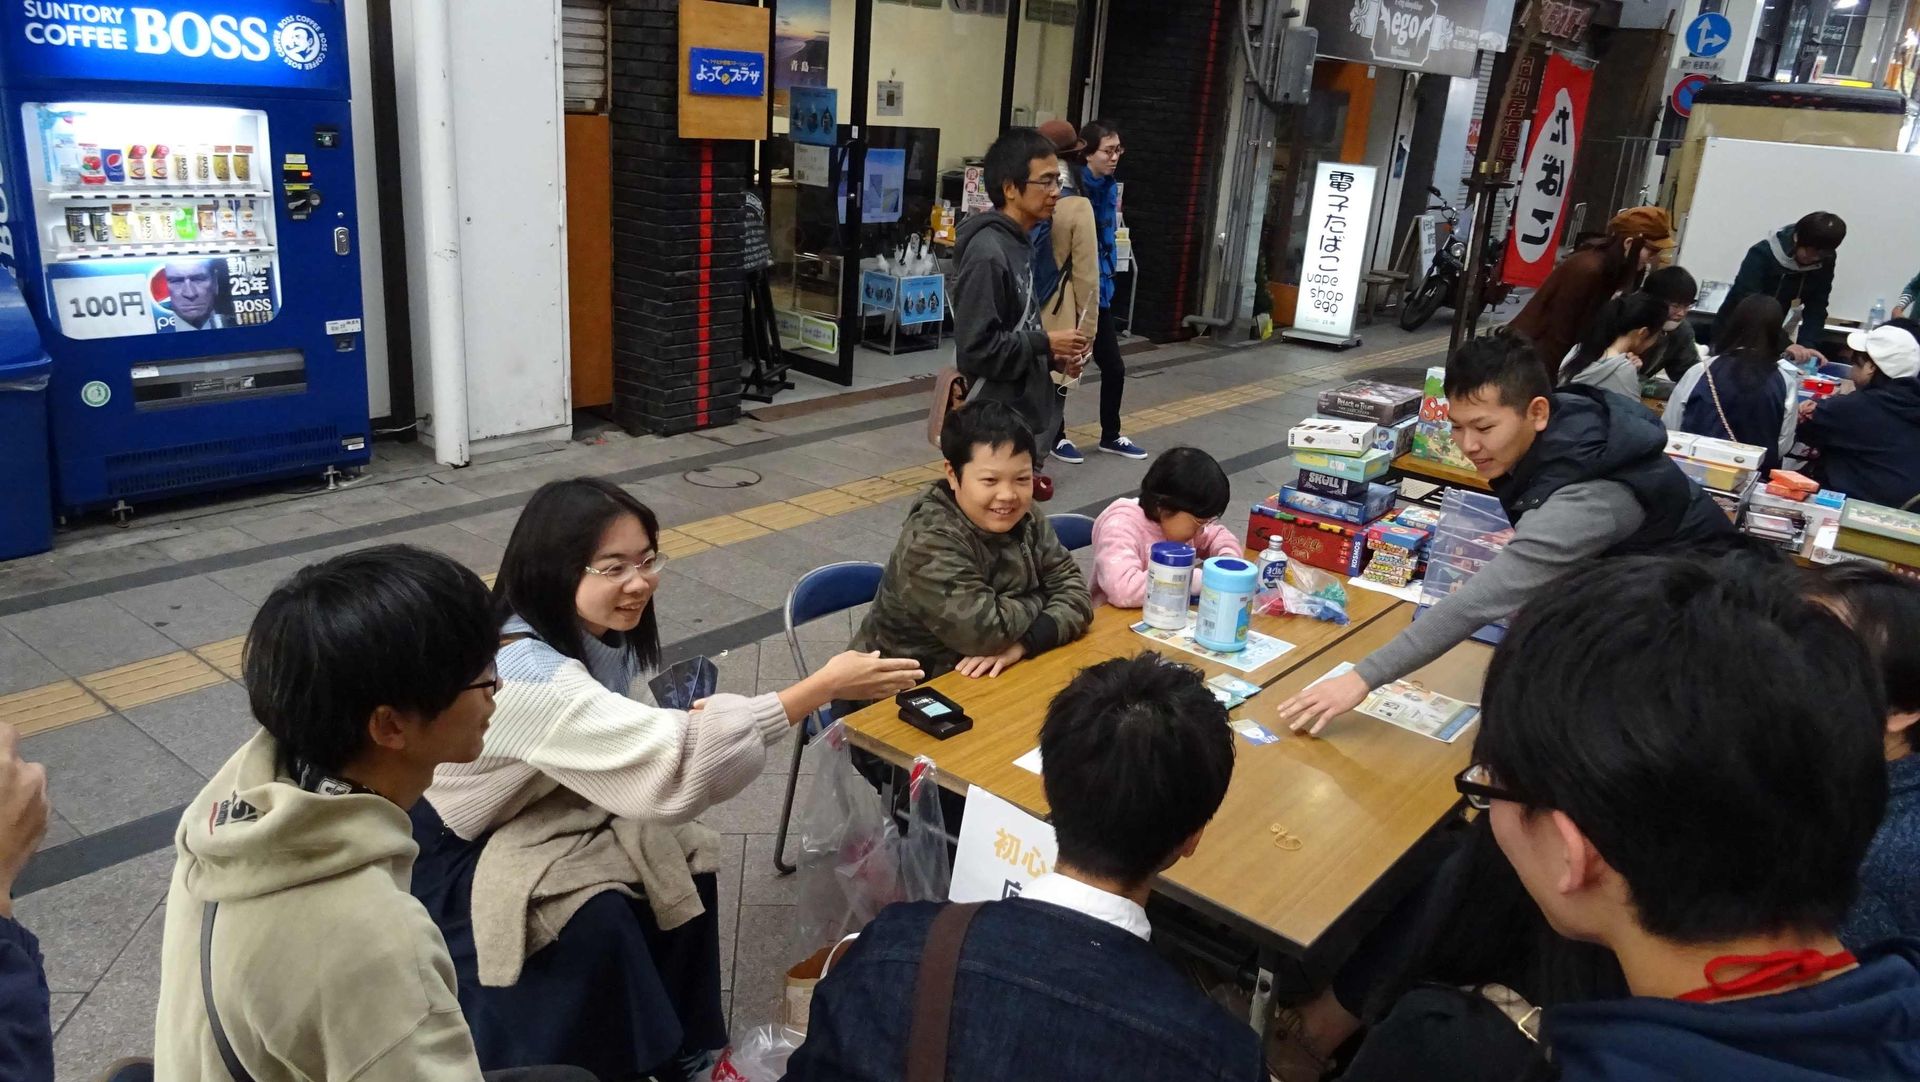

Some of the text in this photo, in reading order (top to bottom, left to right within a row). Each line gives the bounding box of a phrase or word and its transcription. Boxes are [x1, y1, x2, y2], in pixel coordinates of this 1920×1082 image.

[24, 0, 125, 24] SUNTORY
[24, 22, 129, 50] COFFEE
[130, 7, 271, 62] BOSS
[1318, 170, 1355, 272] 電子たばこ
[229, 276, 269, 296] 25年
[1306, 272, 1339, 287] vape
[69, 291, 147, 319] 100円
[233, 298, 272, 313] BOSS
[1310, 287, 1344, 302] shop
[1313, 299, 1339, 314] ego
[1308, 471, 1340, 489] SKULL
[1351, 541, 1361, 568] KOSMOS
[994, 827, 1048, 879] 初心
